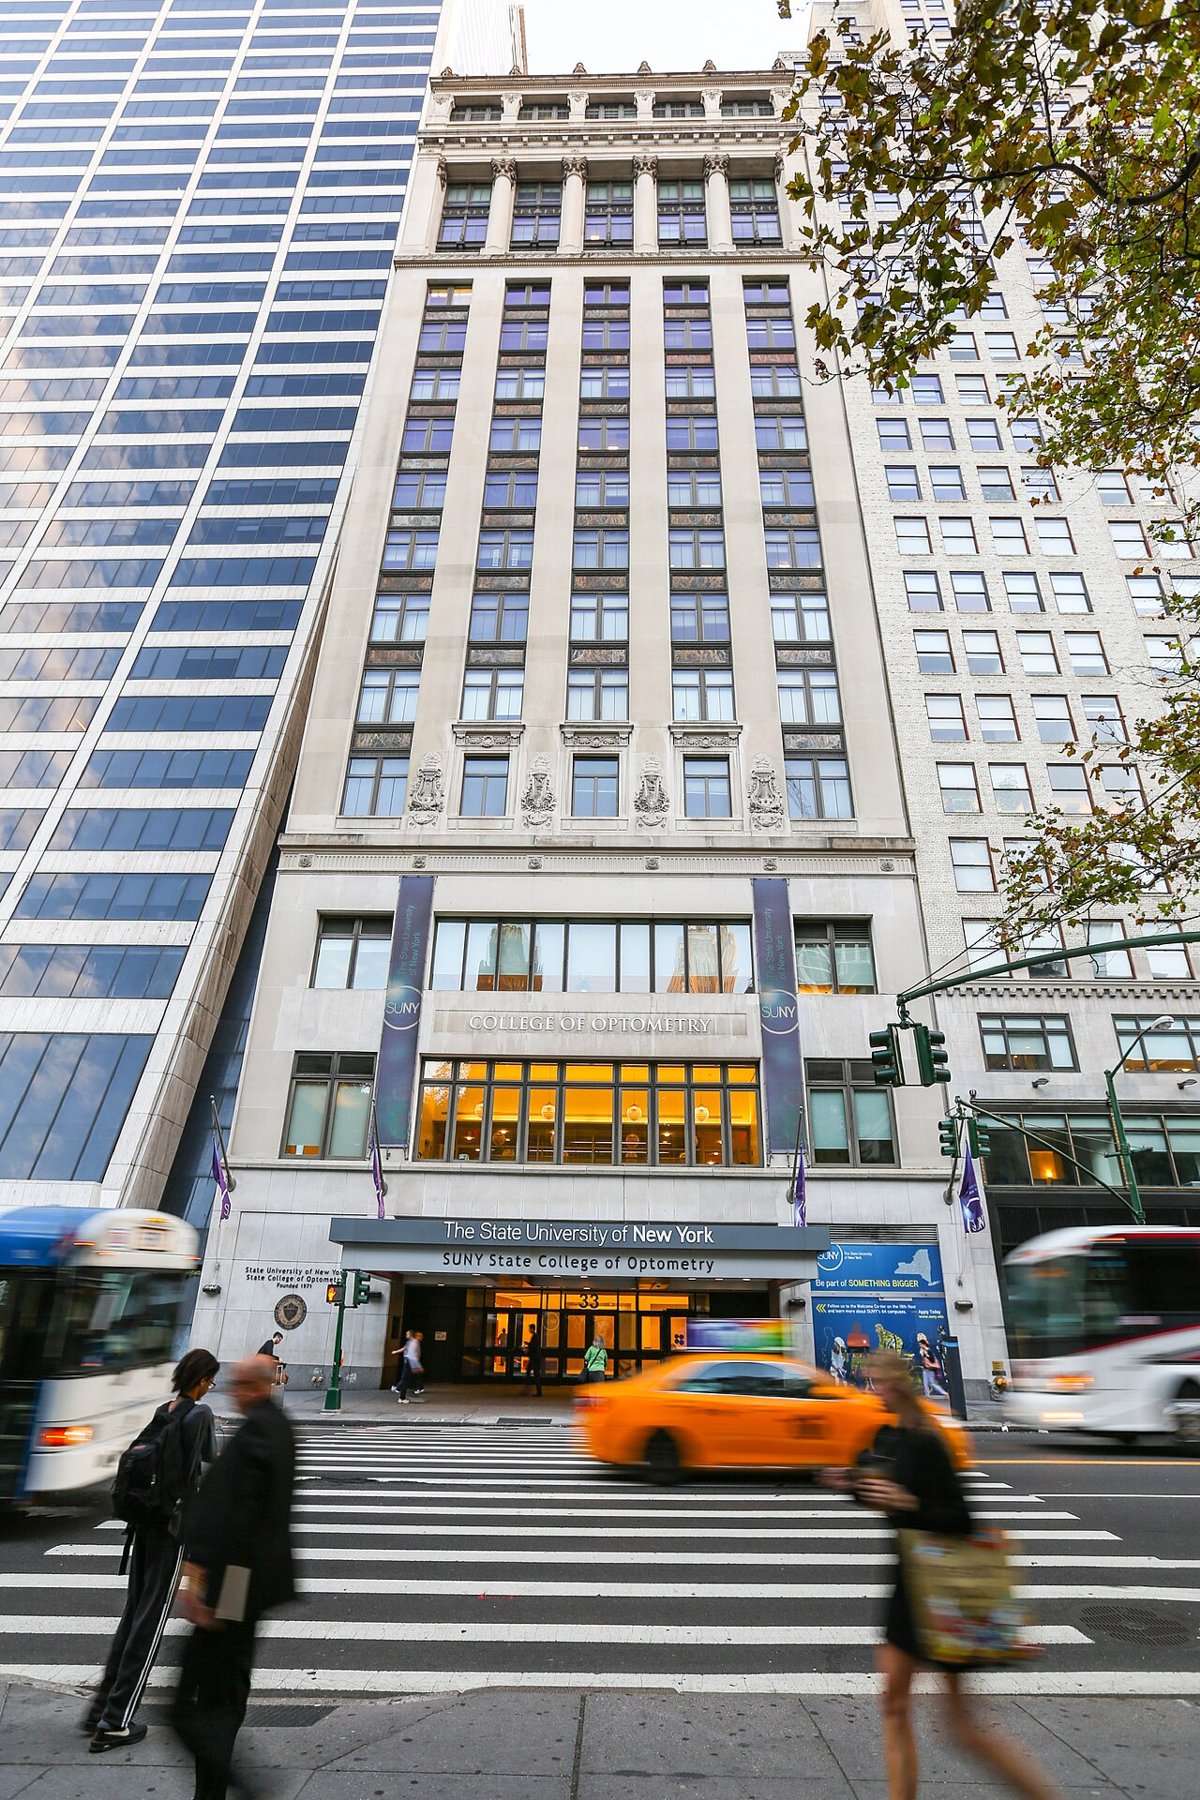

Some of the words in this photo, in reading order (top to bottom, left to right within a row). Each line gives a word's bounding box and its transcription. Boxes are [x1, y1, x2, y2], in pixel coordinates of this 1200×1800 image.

[385, 1001, 420, 1015] SUNY
[761, 1006, 796, 1018] SUNY
[469, 1015, 554, 1031] COLLEGE
[560, 1017, 586, 1032] OF
[591, 1017, 712, 1034] OPTOMETRY
[443, 1221, 475, 1239] The
[480, 1222, 522, 1240] State
[526, 1223, 609, 1247] University
[611, 1225, 629, 1242] of
[633, 1225, 673, 1243] New
[676, 1226, 715, 1243] York
[443, 1252, 484, 1266] SUNY
[489, 1254, 532, 1268] State
[538, 1255, 599, 1272] College
[605, 1256, 621, 1269] of
[627, 1256, 714, 1273] Optometry
[266, 1267, 303, 1276] University
[267, 1275, 294, 1283] College
[826, 1279, 839, 1288] part
[840, 1279, 847, 1287] of
[891, 1280, 920, 1288] BIGGER
[578, 1293, 599, 1309] 33
